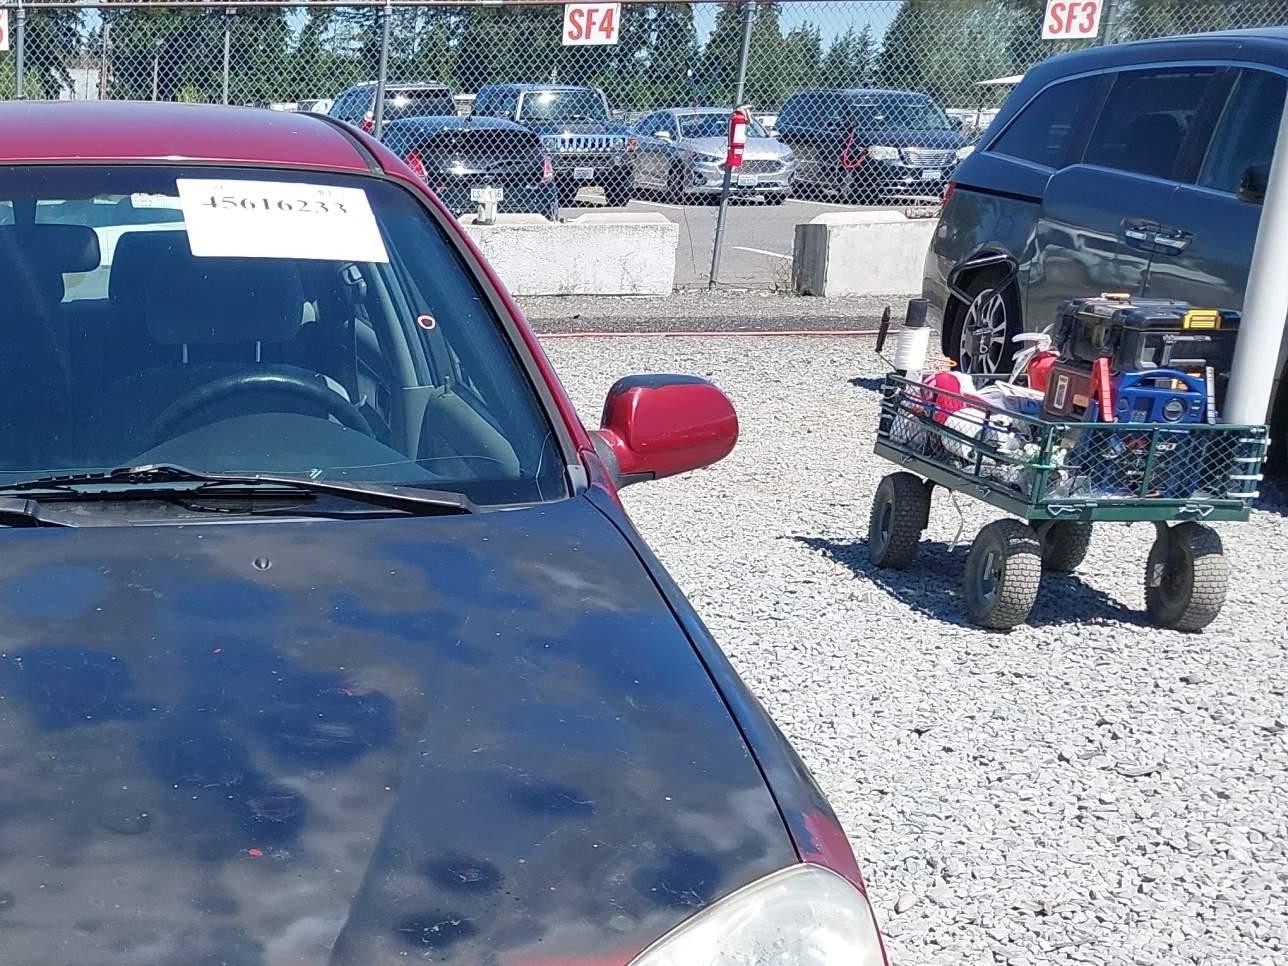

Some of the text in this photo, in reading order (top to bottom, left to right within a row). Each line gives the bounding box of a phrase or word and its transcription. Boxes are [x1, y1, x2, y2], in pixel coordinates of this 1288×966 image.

[567, 8, 615, 41] SF4
[1048, 1, 1097, 34] SF3
[201, 195, 348, 214] 45616233
